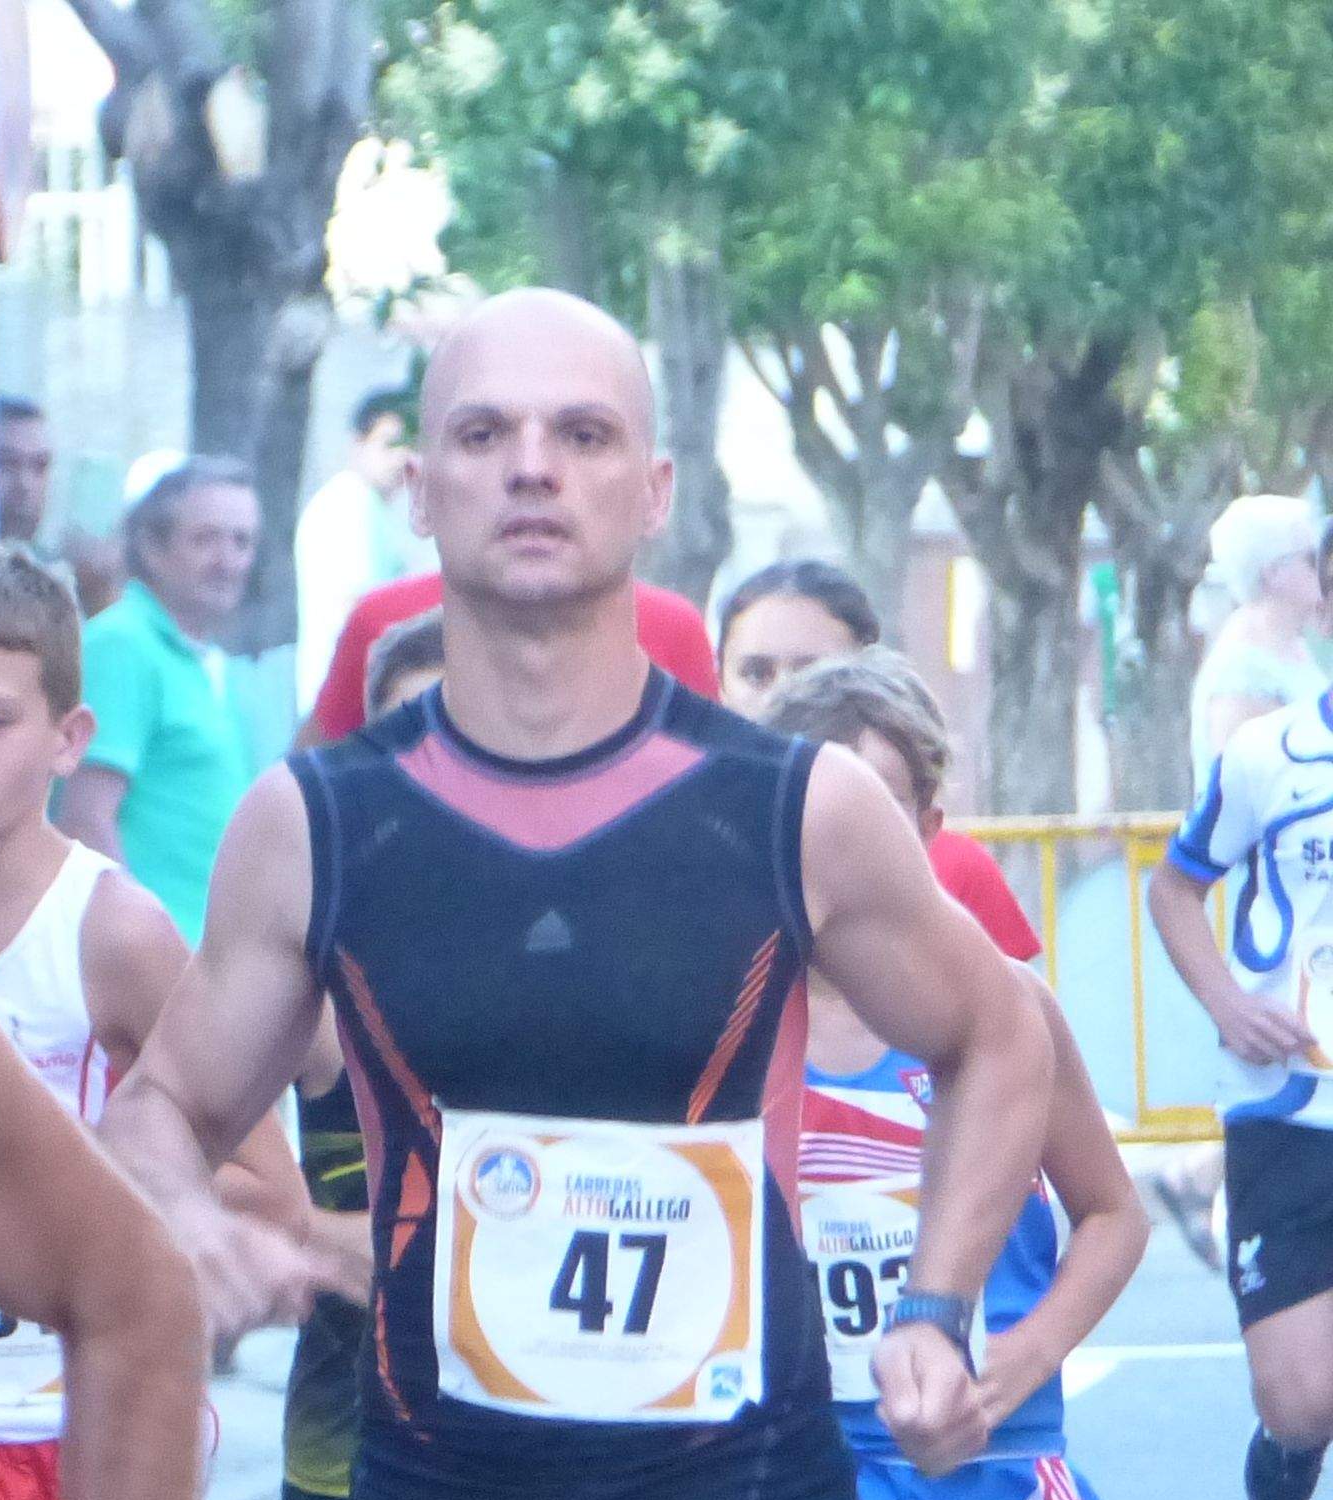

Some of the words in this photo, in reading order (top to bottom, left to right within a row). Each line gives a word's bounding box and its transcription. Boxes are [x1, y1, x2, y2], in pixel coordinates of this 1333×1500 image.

[565, 1174, 643, 1198] CARRERAS
[562, 1196, 691, 1222] ALTOGALLEGO
[549, 1229, 668, 1335] 47
